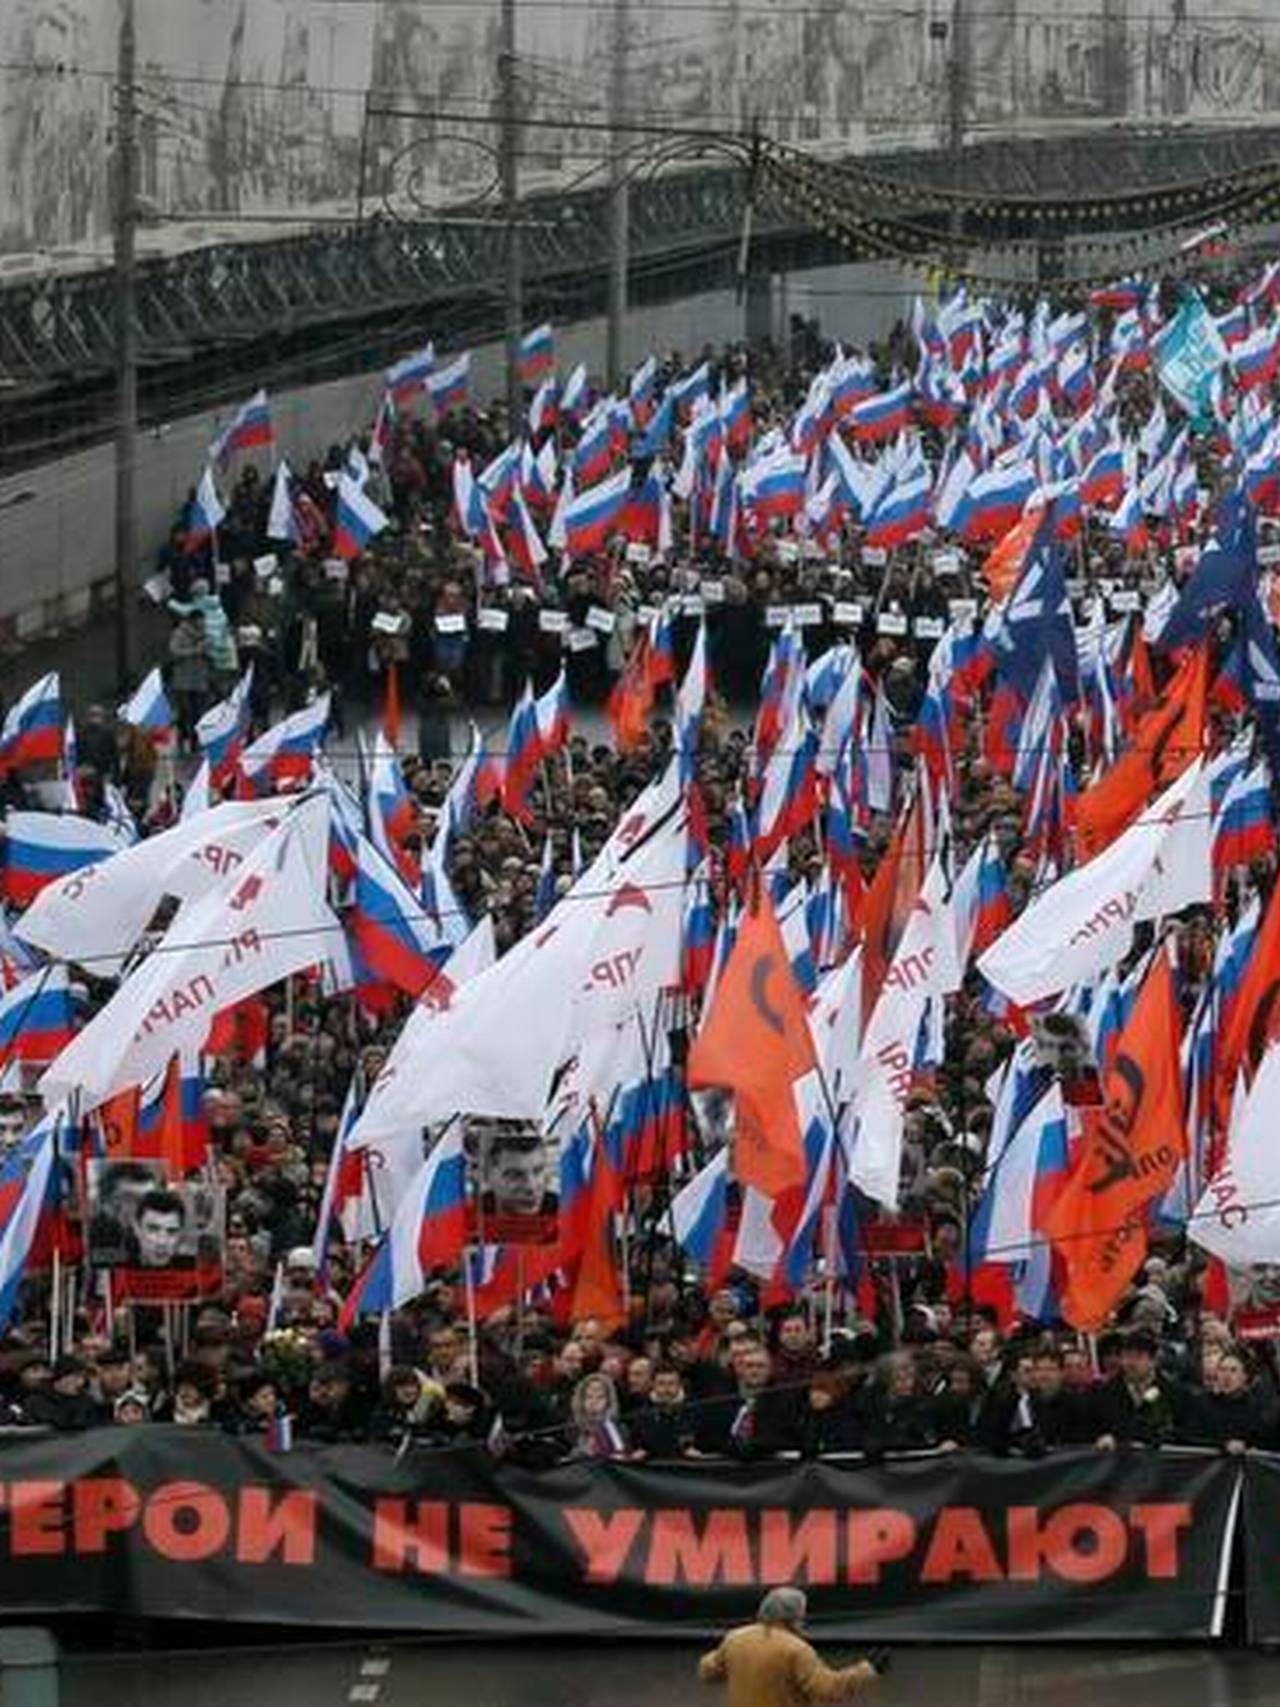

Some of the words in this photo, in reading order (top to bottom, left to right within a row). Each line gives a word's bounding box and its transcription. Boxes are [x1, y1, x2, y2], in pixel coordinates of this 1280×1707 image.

[0, 1478, 316, 1564] ЕРОИ
[373, 1497, 510, 1577] НЕ
[566, 1503, 1191, 1585] УМИРАЮТ
